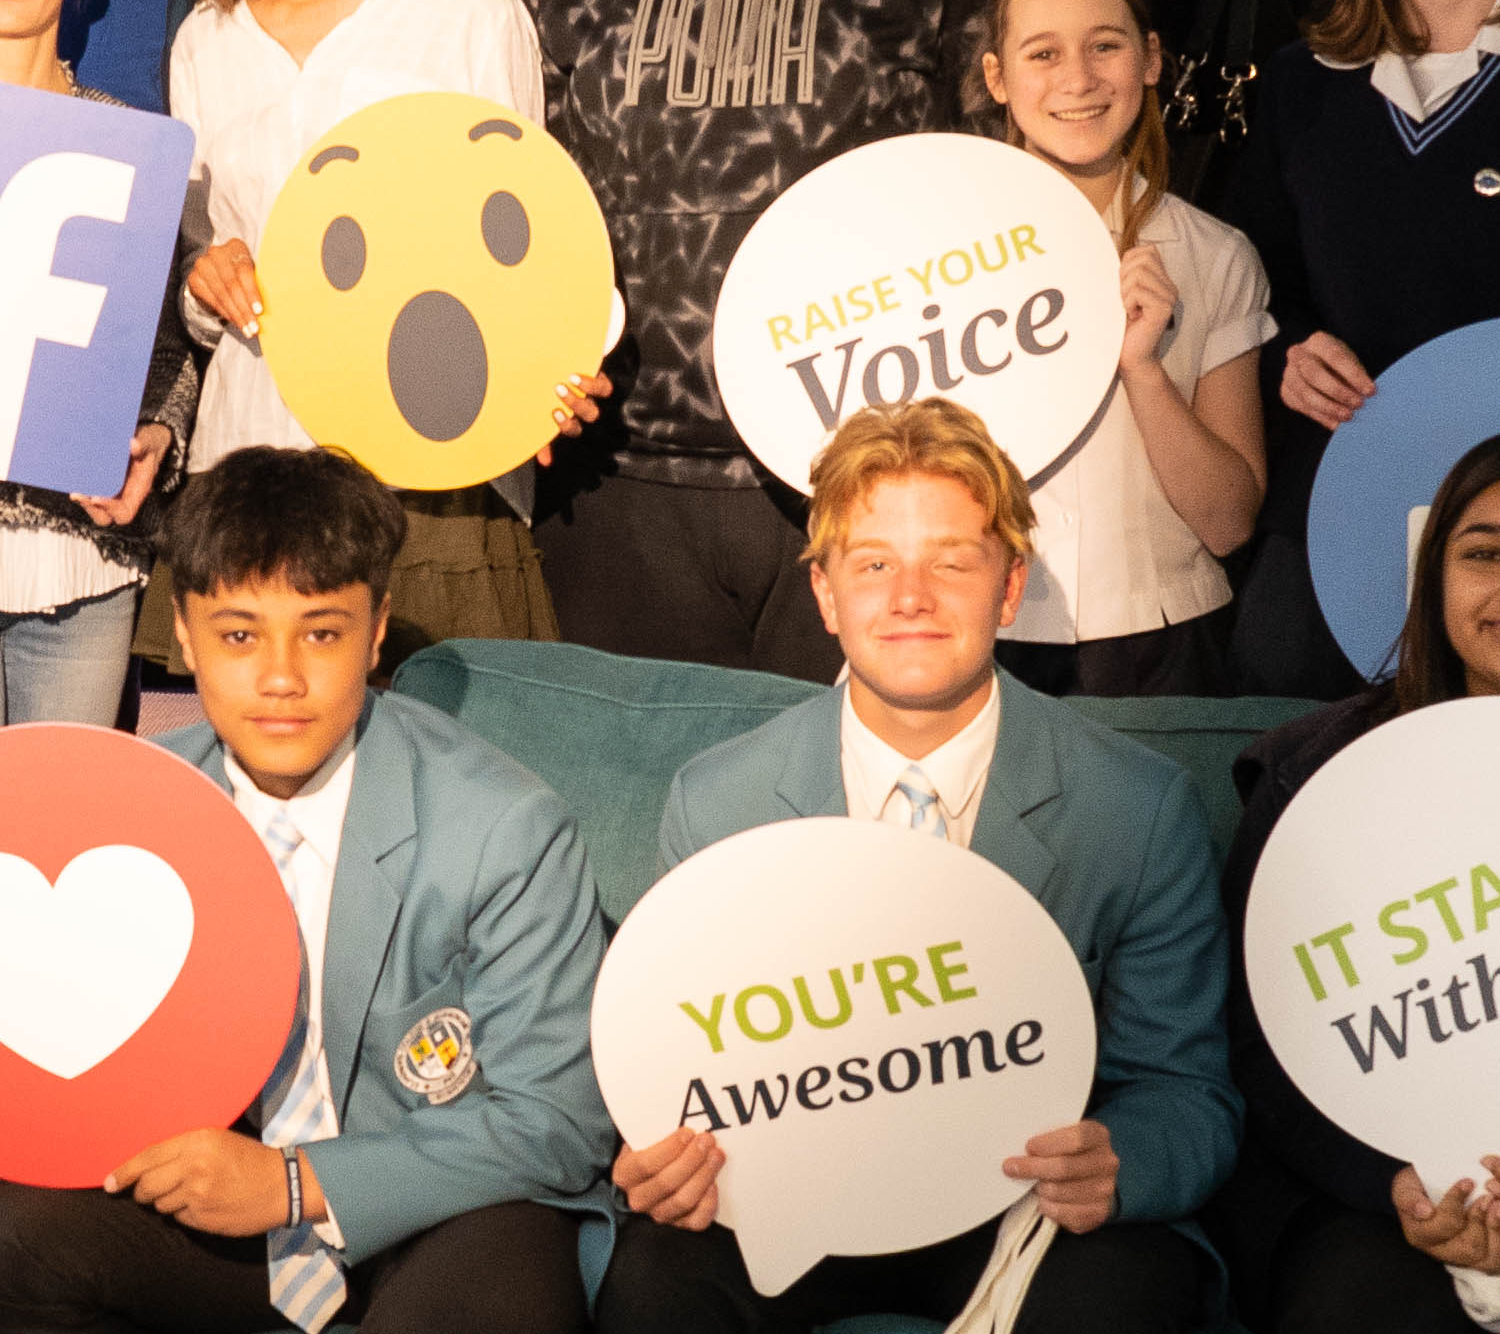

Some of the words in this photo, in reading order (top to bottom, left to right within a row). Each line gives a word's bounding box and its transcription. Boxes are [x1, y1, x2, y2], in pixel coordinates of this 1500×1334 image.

[766, 275, 901, 352] RAISE
[905, 224, 1046, 297] YOUR
[786, 288, 1069, 432] Voice
[678, 940, 978, 1054] YOU'RE
[1292, 921, 1361, 1003] IT
[678, 1019, 1046, 1133] Awesome
